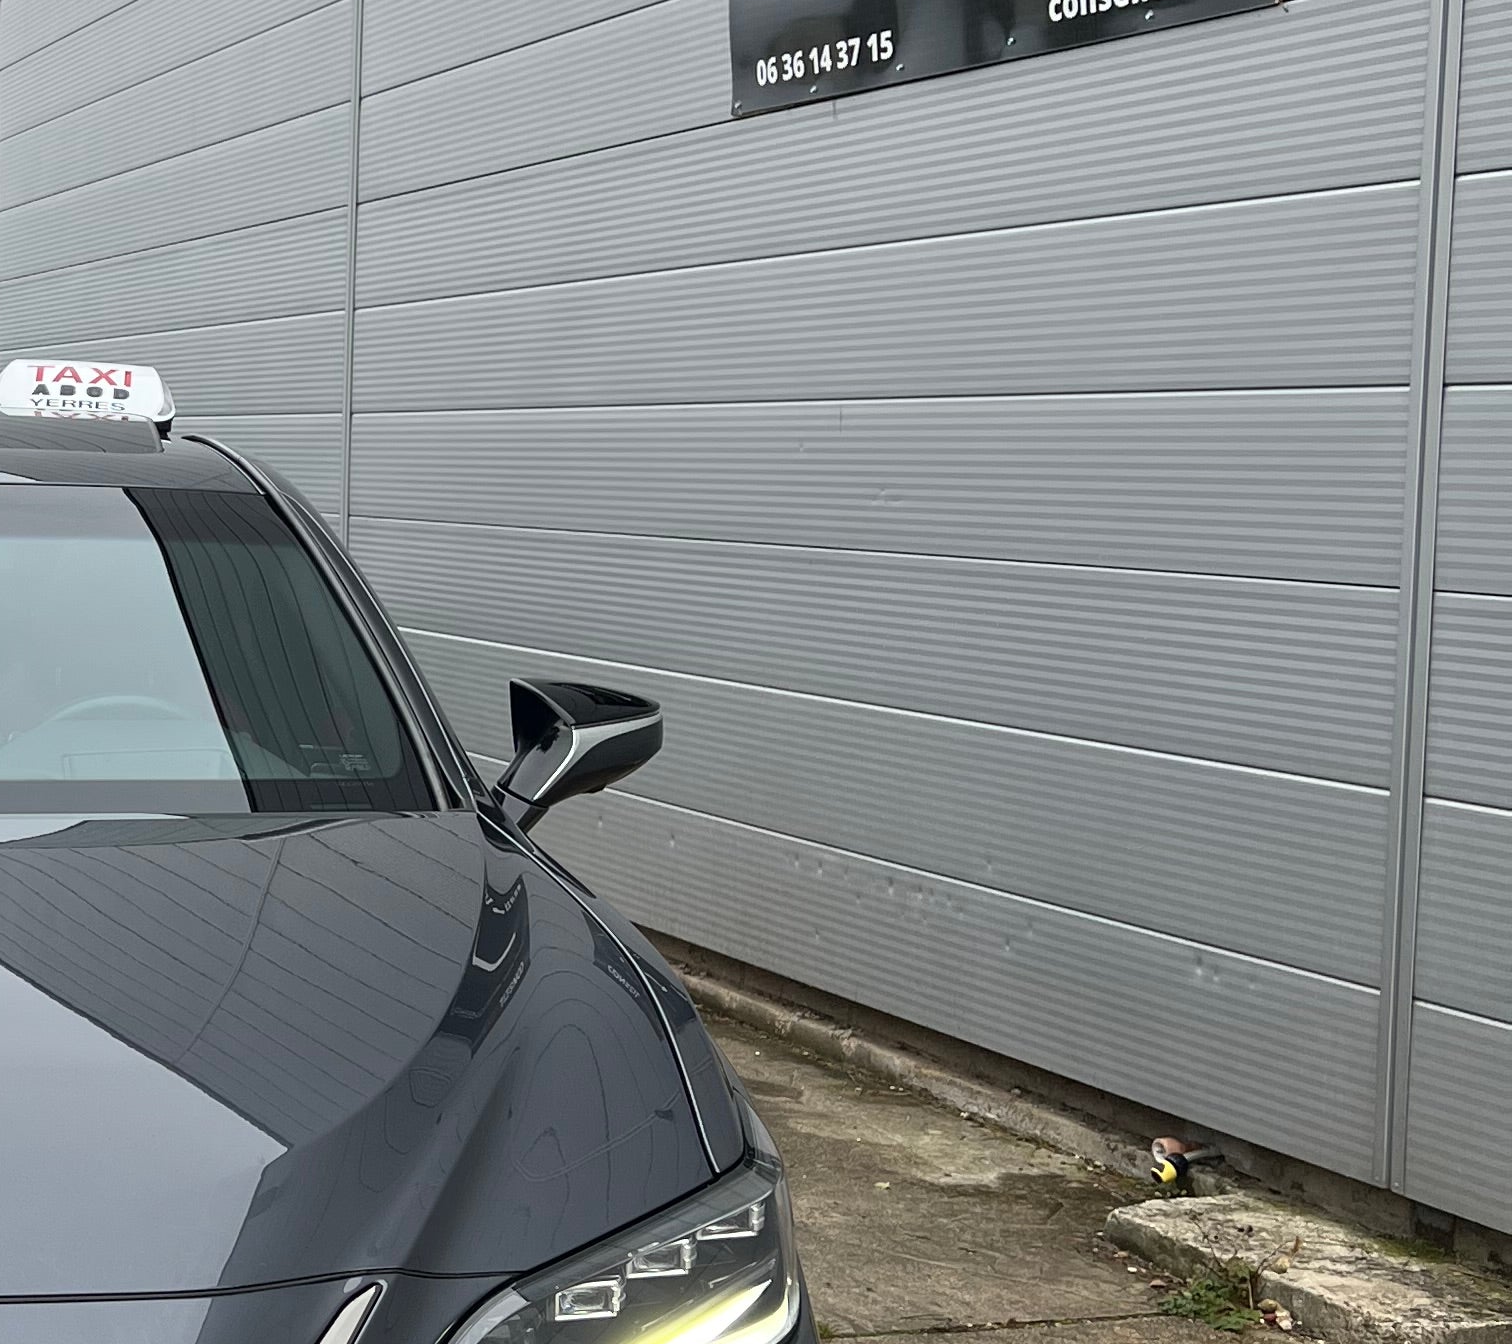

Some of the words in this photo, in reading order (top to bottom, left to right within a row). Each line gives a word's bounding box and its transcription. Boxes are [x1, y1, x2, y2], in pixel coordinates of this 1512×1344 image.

[756, 56, 778, 87] 06
[781, 49, 805, 81] 36
[809, 44, 833, 75] 14
[835, 37, 861, 69] 37
[866, 29, 894, 62] 15
[27, 365, 132, 387] TAXI
[29, 398, 126, 411] YERRES
